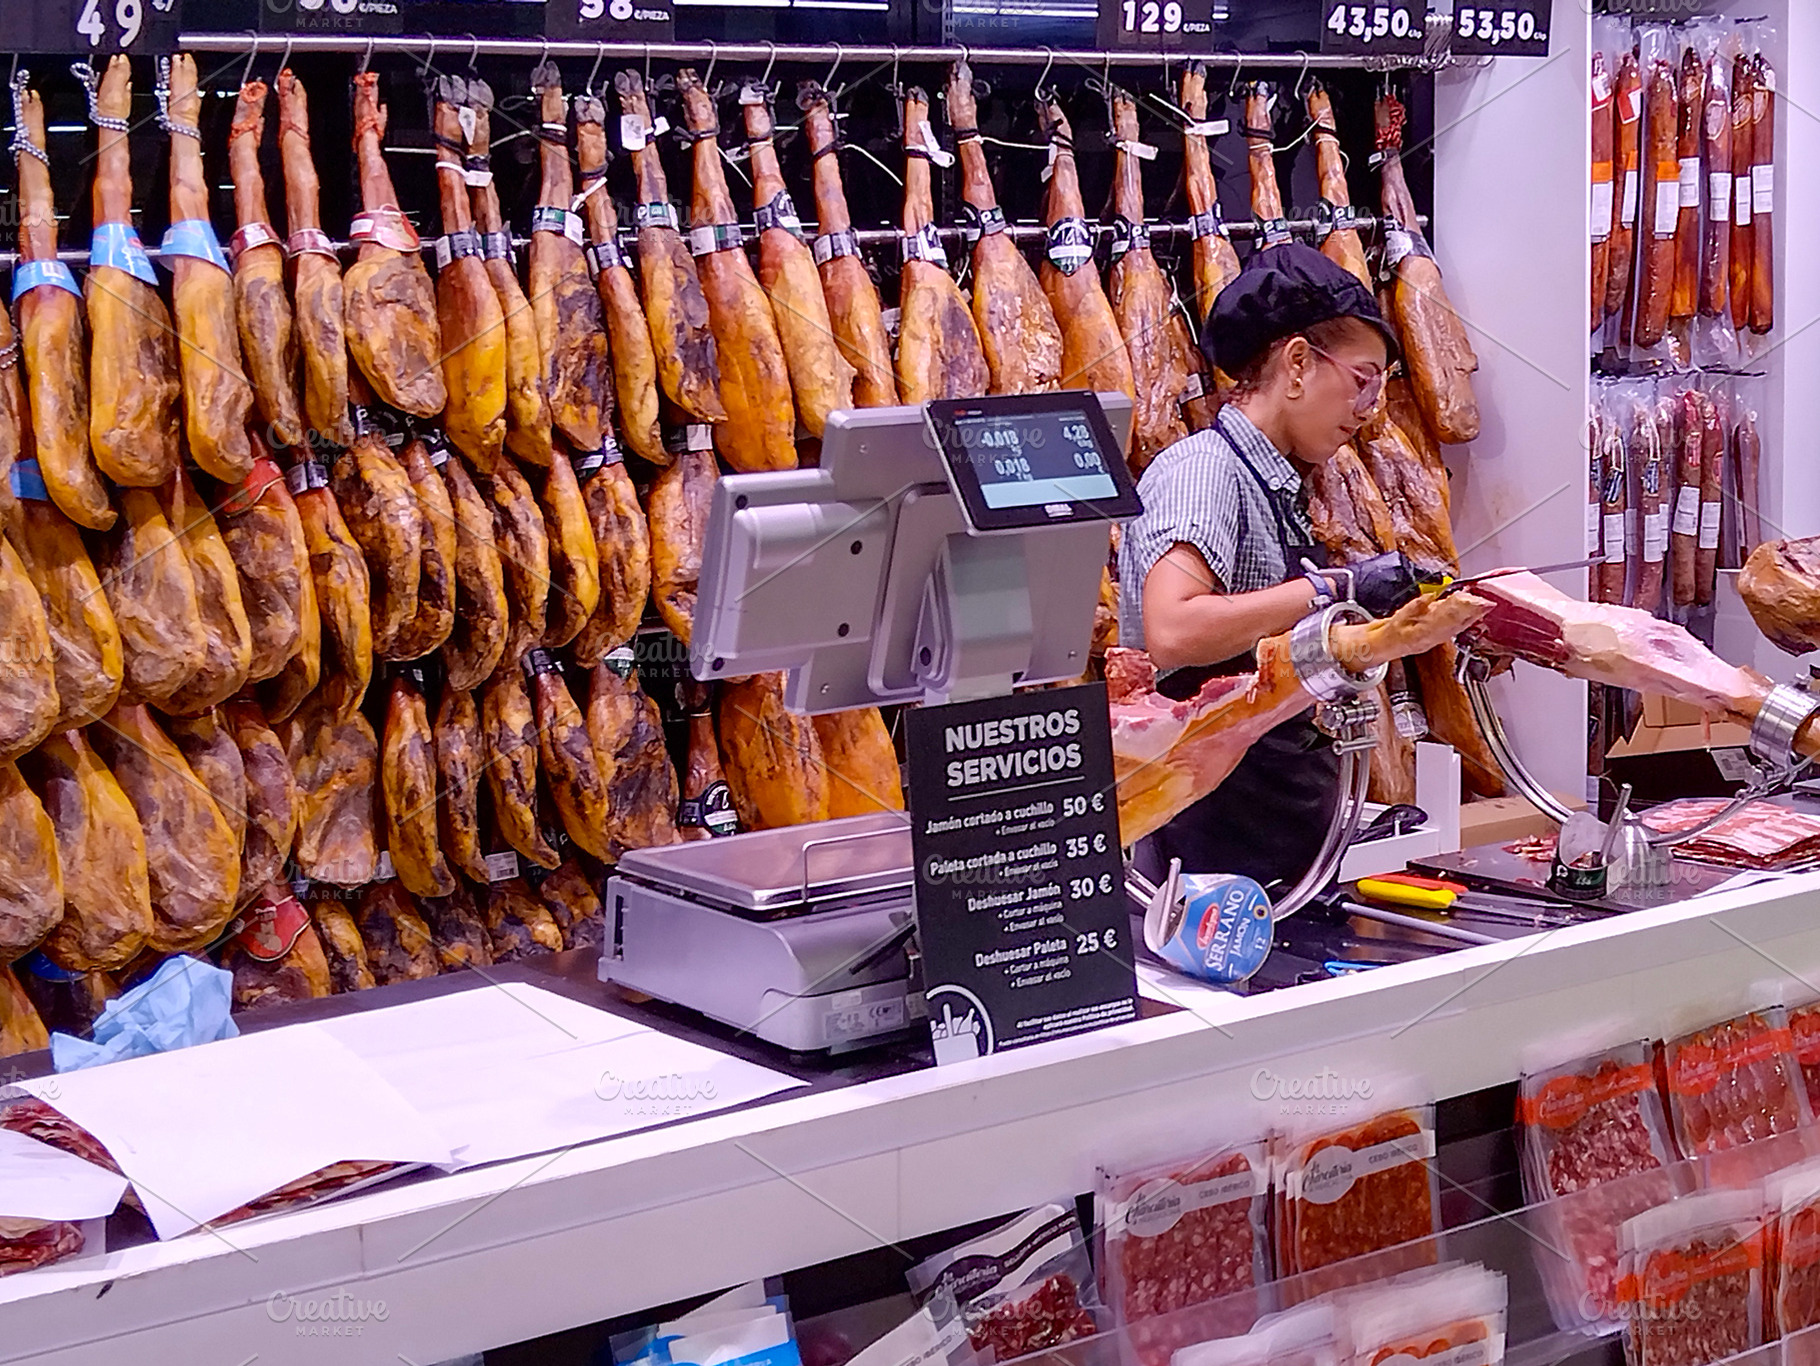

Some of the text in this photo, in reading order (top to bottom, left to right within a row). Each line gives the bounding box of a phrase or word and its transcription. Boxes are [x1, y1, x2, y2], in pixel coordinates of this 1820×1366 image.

[77, 0, 143, 47] 49
[1122, 1, 1182, 33] 129
[1327, 4, 1410, 43] 43,50
[1457, 8, 1535, 46] 53,50
[945, 709, 1081, 753] NUESTROS
[946, 743, 1082, 787] SERVICIOS
[925, 792, 1105, 834] Jamón cortado a cuchillo 50 €
[966, 852, 1007, 870] cortada
[1007, 850, 1015, 862] a
[1016, 842, 1058, 860] cuchillo
[1065, 836, 1089, 858] 35
[1093, 833, 1107, 853] €
[967, 873, 1113, 912] Deshuesar Jamón 30 €
[974, 928, 1118, 967] Deshuesar Paleta 25 €
[1204, 890, 1245, 971] SERRANO
